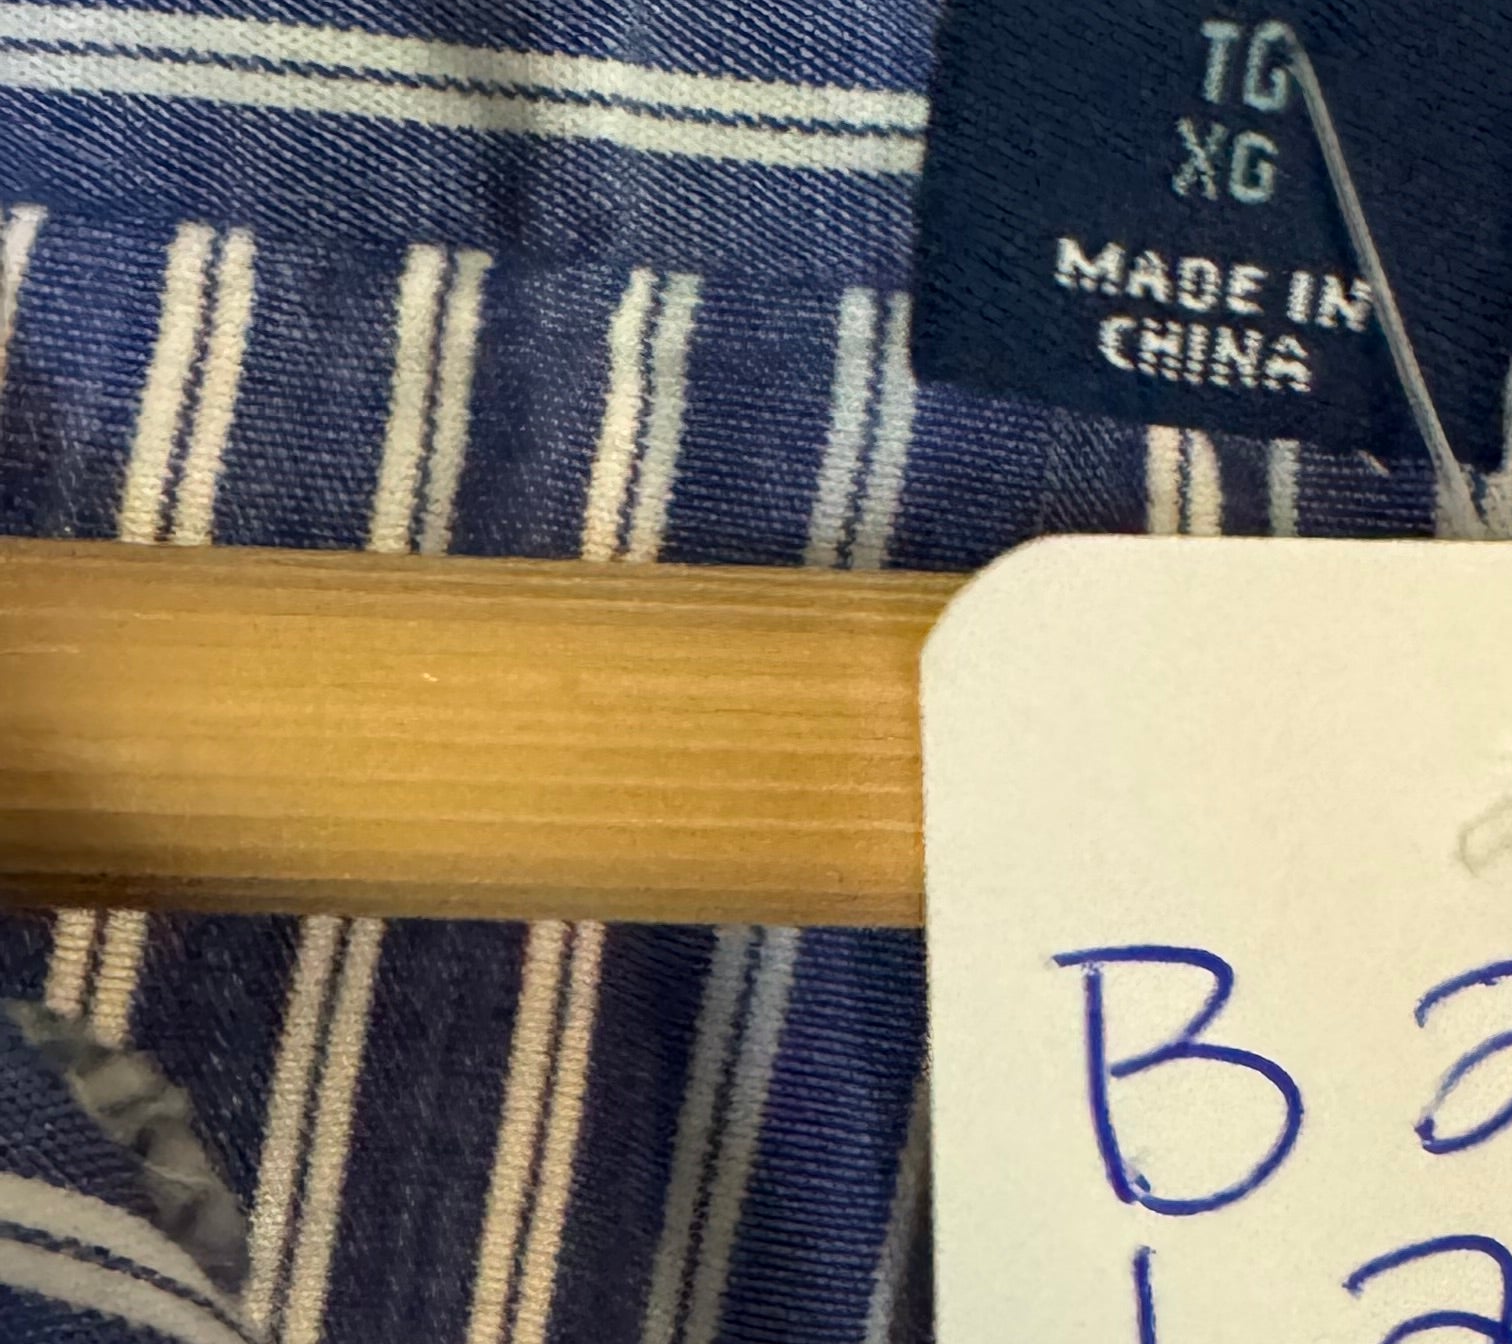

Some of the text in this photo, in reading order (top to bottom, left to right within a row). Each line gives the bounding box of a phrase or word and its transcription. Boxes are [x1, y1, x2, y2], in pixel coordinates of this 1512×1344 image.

[1201, 20, 1298, 113] TG
[1171, 118, 1279, 204] XG
[1054, 236, 1375, 333] MADE IN
[1097, 317, 1311, 393] CHINA
[1051, 944, 1305, 1218] B
